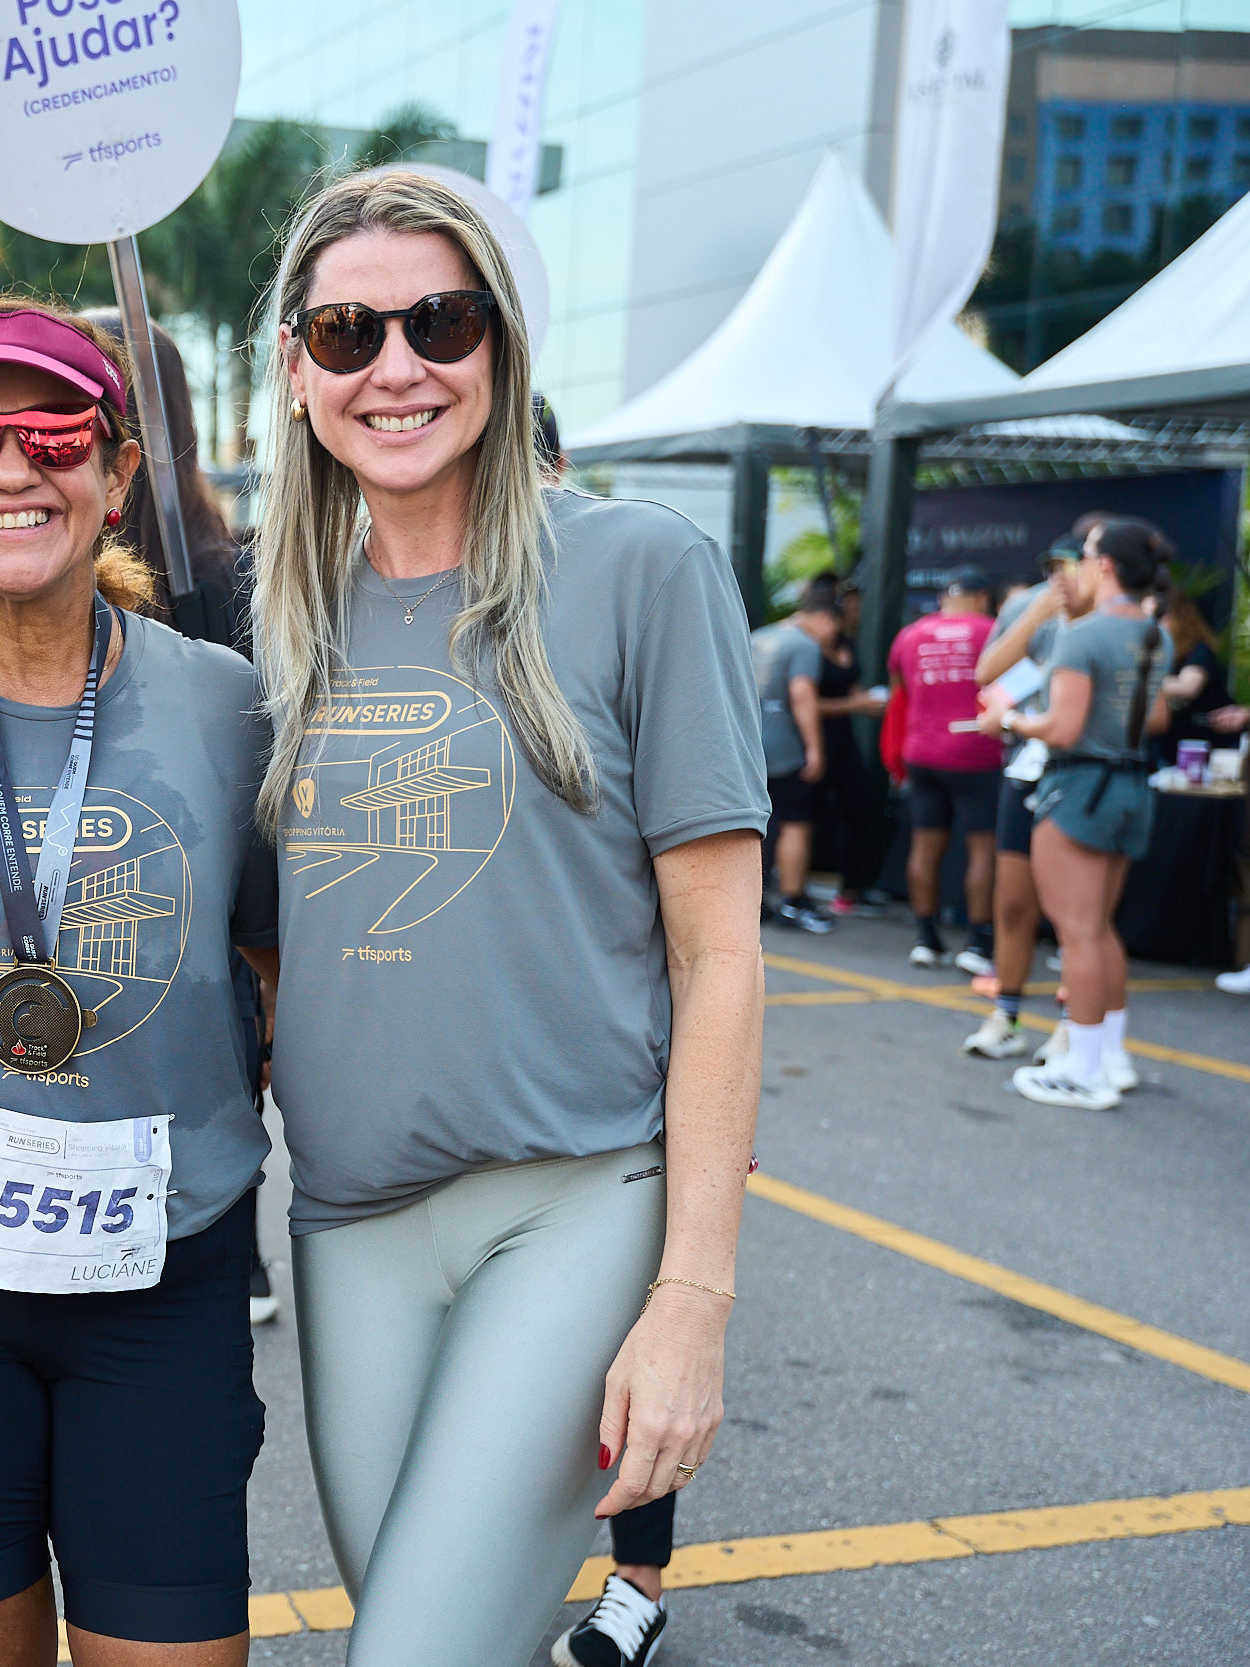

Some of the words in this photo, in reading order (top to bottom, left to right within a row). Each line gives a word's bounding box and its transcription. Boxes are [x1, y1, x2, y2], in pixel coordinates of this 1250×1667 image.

[3, 0, 180, 88] Ajudar?
[23, 65, 177, 118] (CREDENCIAMENTO)
[88, 131, 162, 164] tfsports
[310, 702, 436, 723] RUNSERIES
[0, 815, 14, 844] CORRE
[313, 825, 346, 837] VITÓRIA
[6, 844, 23, 891] ENTENDE
[357, 945, 412, 964] tfsports
[8, 1135, 56, 1150] RUNSERIES
[70, 1258, 158, 1281] LUCIANE
